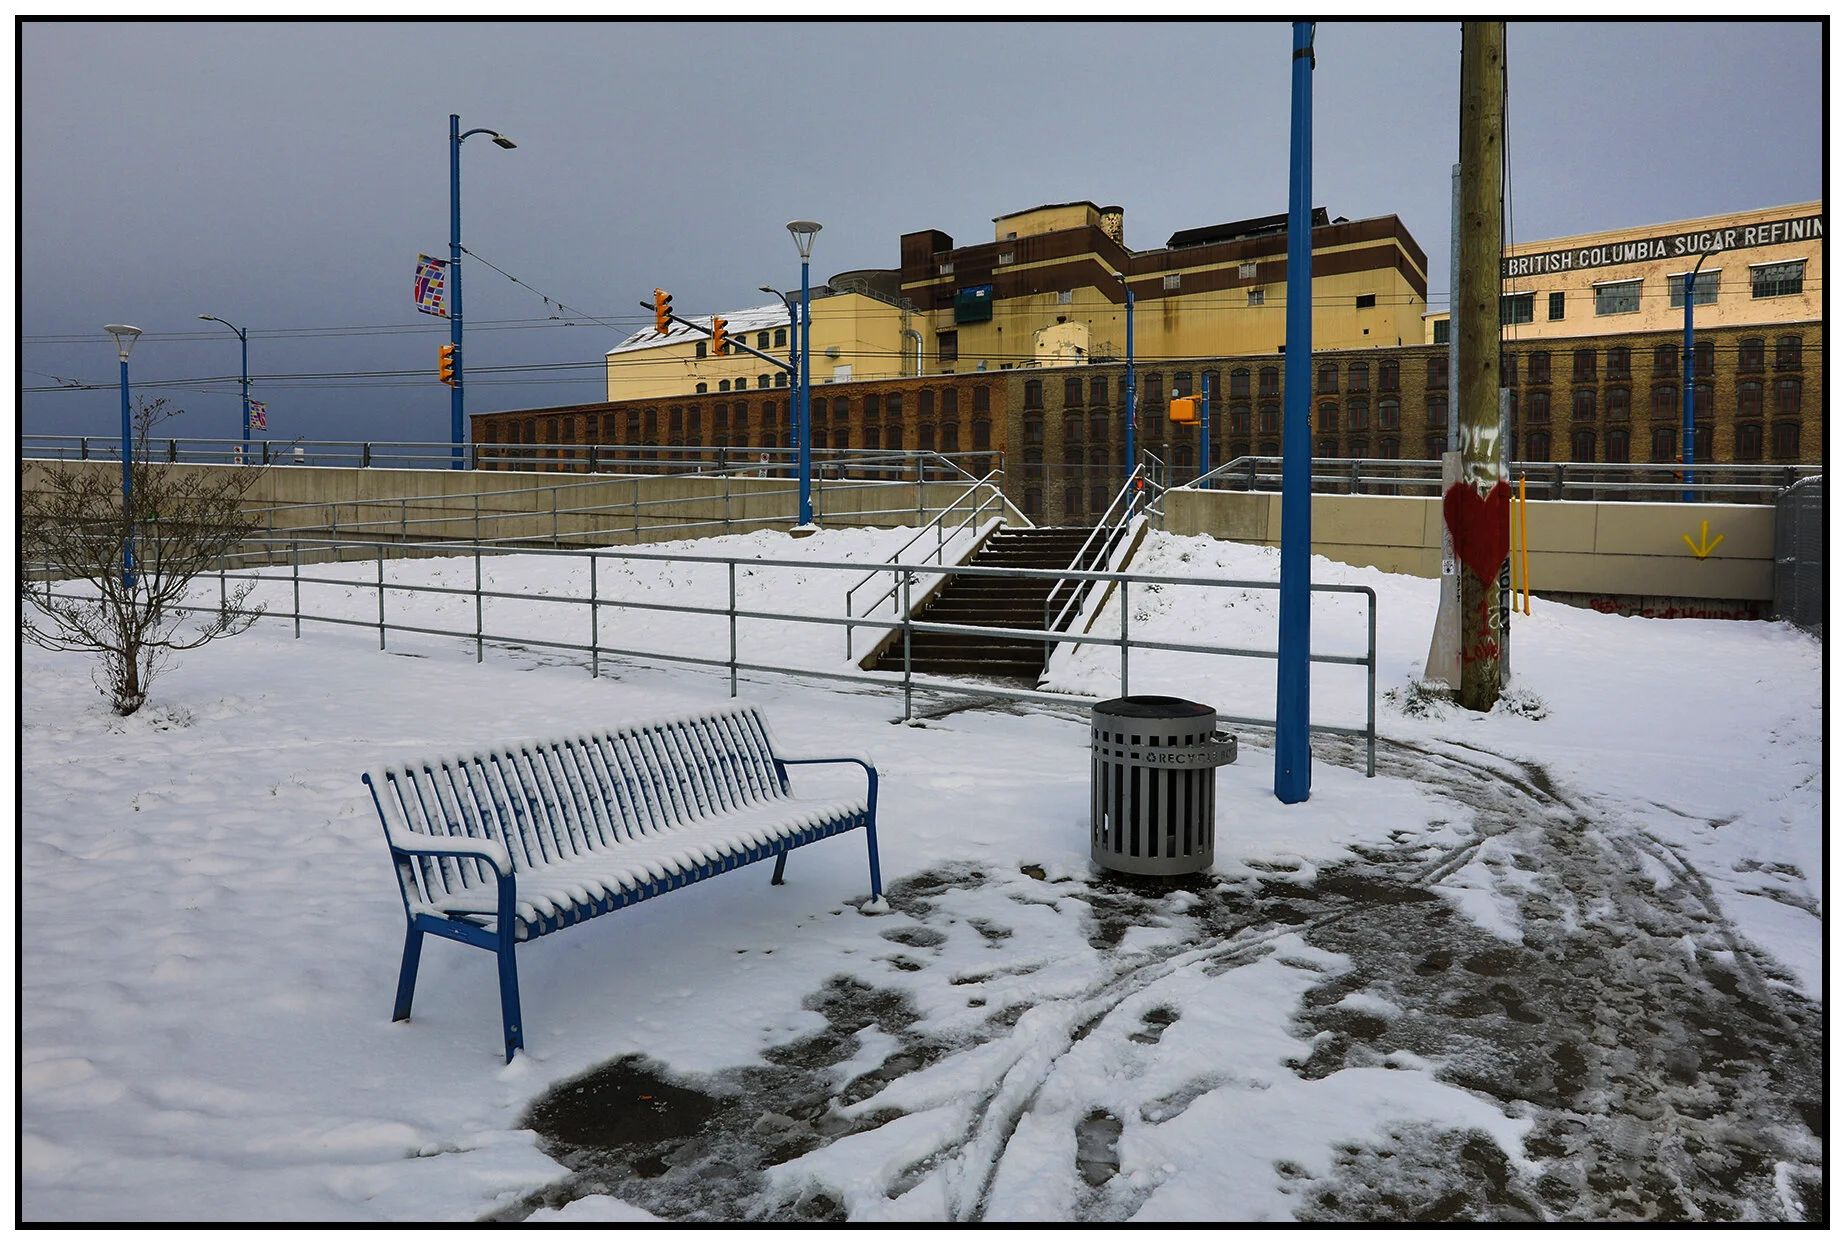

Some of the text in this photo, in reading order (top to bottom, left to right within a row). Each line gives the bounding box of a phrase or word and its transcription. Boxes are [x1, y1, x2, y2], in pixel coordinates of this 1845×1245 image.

[1508, 218, 1823, 276] BRITISH COLUMBIA SUGAR REFININ
[1159, 751, 1218, 764] RECYCLE
